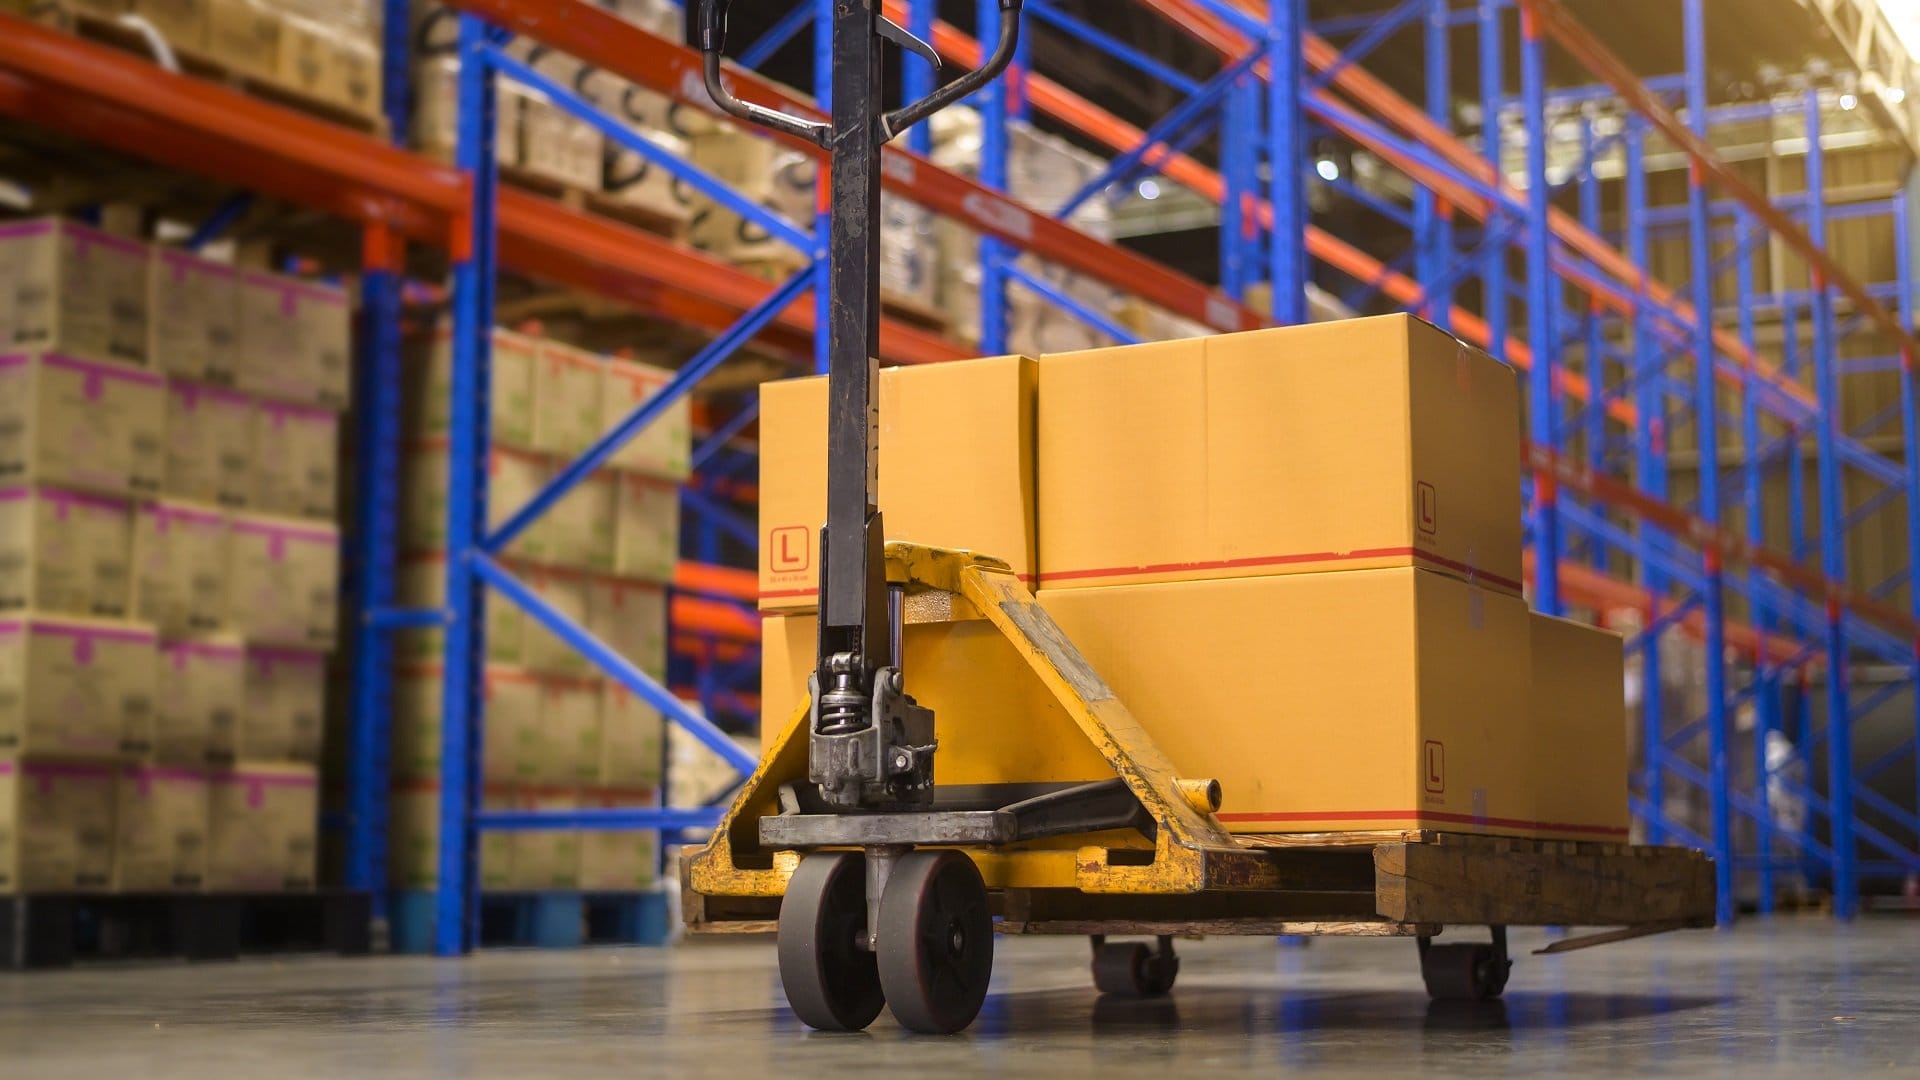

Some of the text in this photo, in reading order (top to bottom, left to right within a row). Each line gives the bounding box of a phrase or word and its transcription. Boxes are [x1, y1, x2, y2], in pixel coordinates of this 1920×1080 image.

[1422, 489, 1432, 524] L
[782, 534, 799, 562] L
[1430, 748, 1440, 783] L
